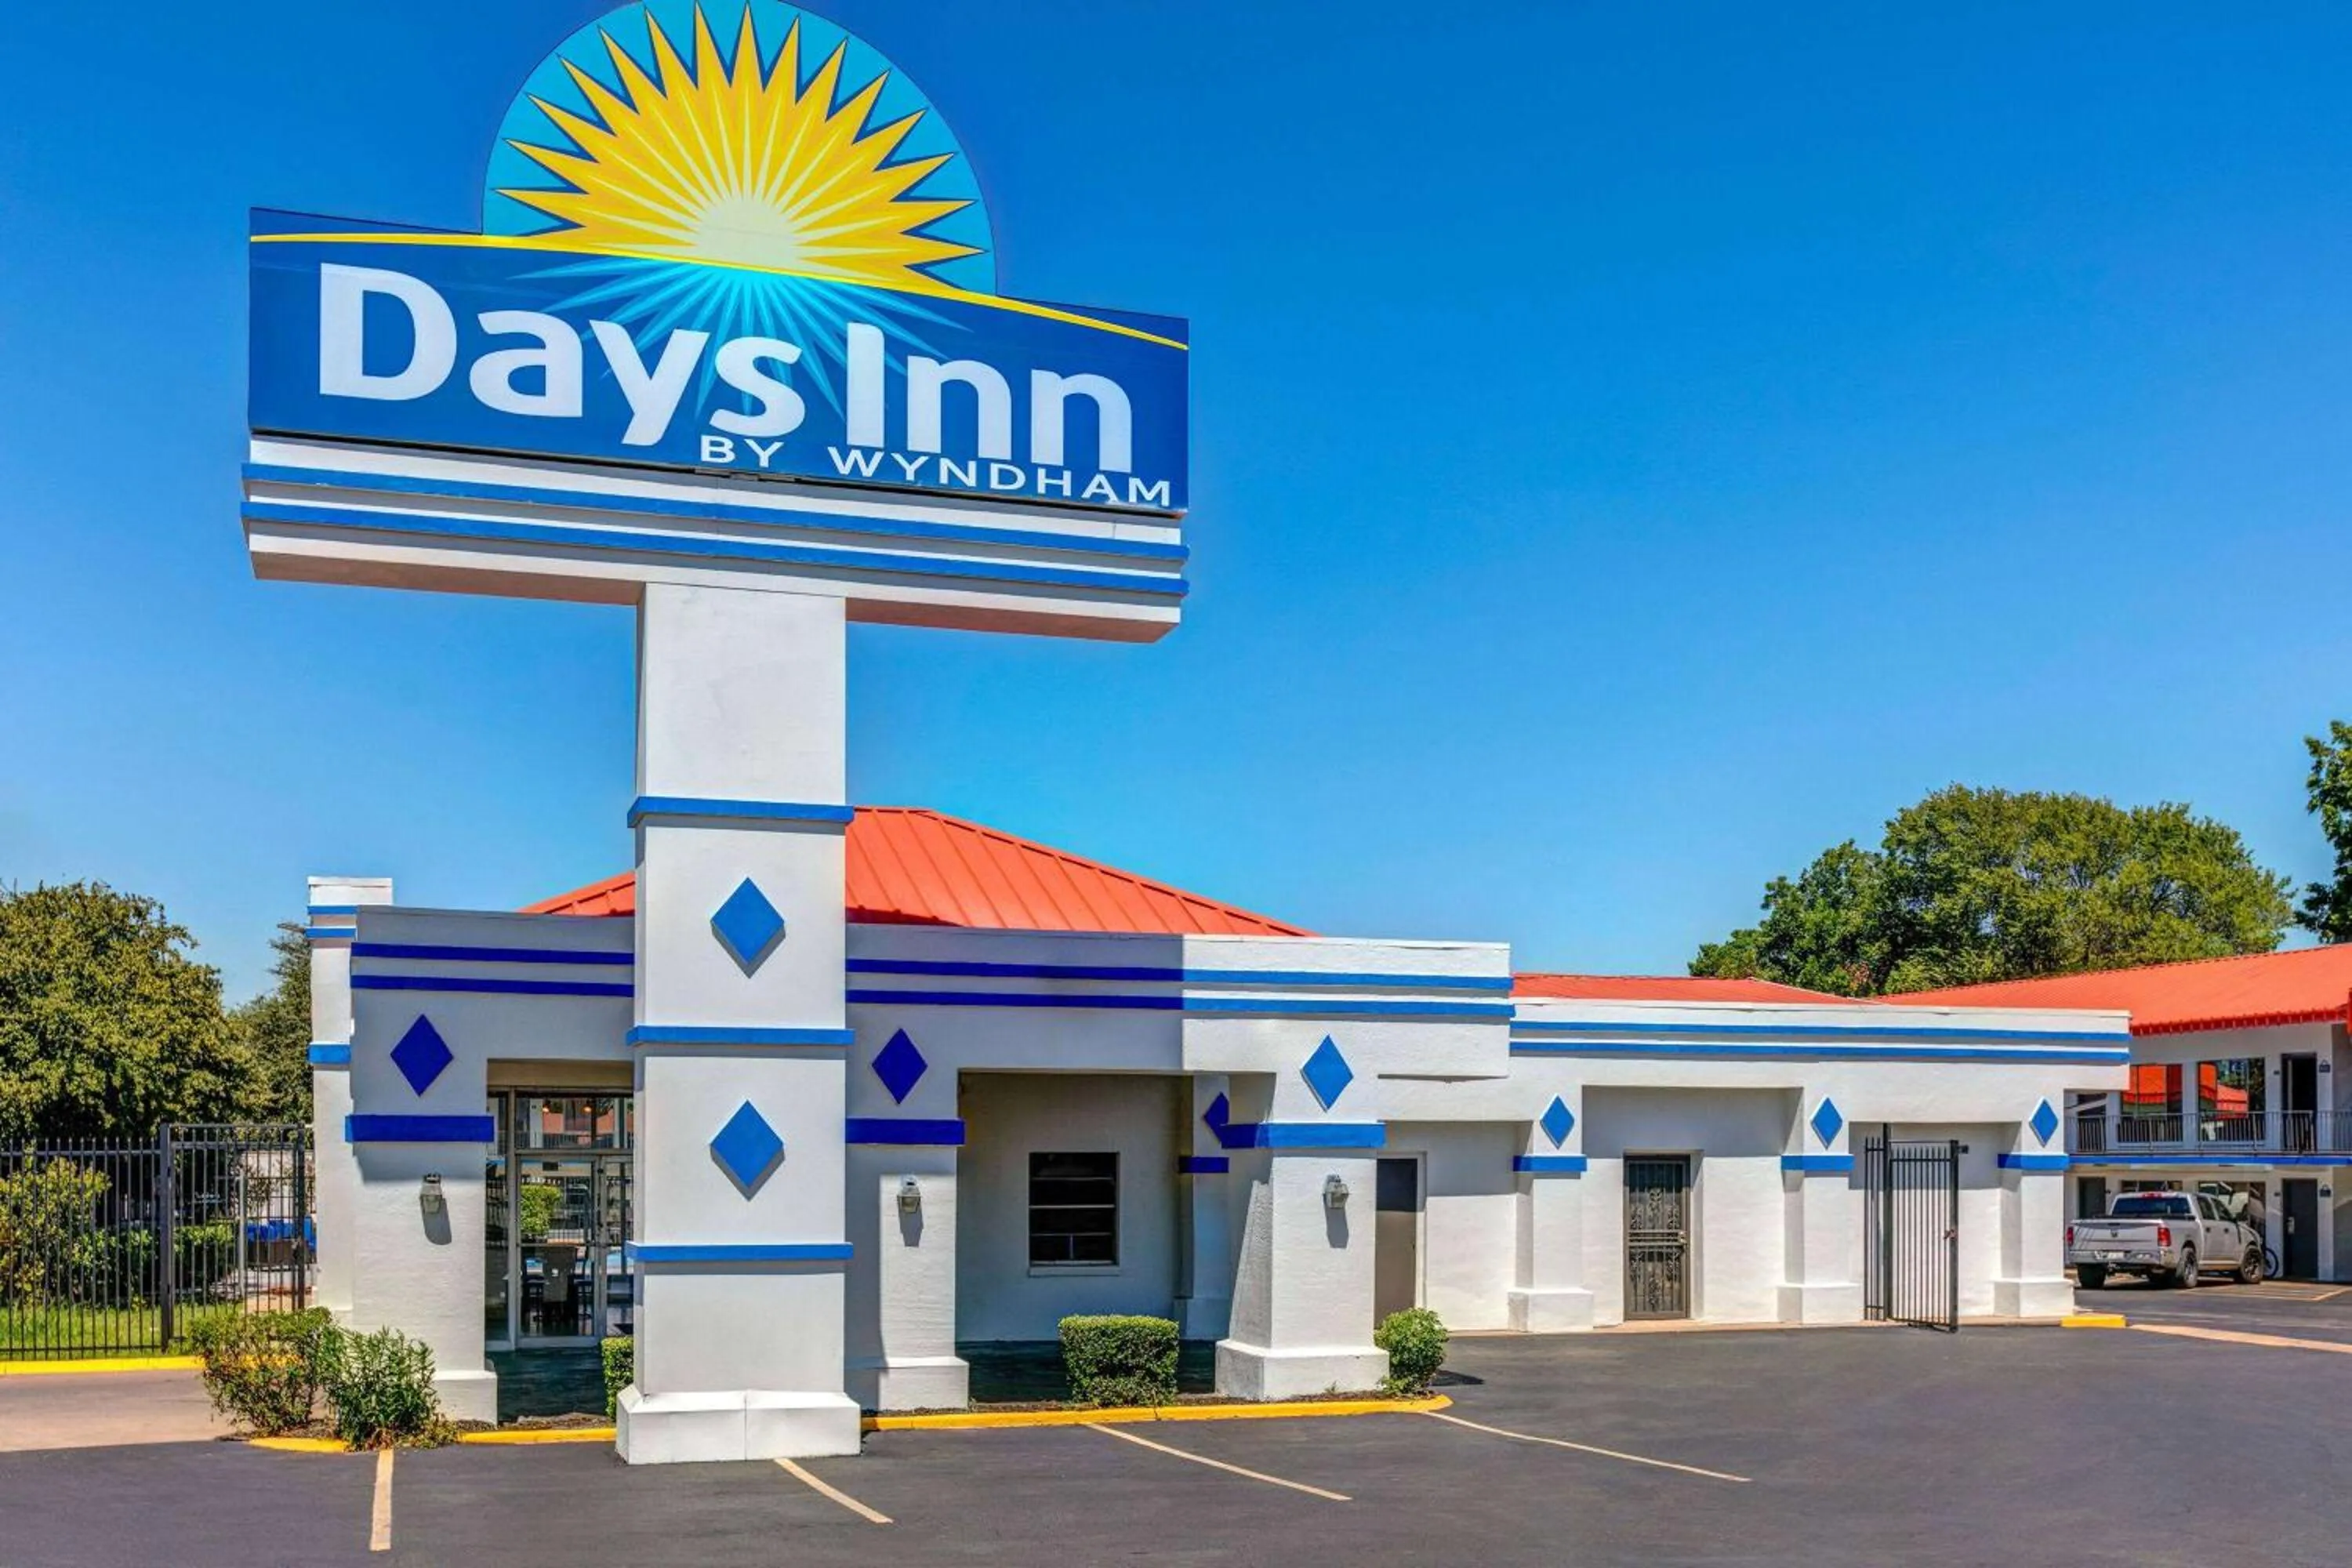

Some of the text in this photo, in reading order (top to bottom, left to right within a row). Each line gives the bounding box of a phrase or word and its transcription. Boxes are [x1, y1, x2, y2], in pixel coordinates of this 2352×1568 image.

[319, 262, 1131, 473] Days Inn
[700, 434, 1171, 507] BY WYNDHAM
